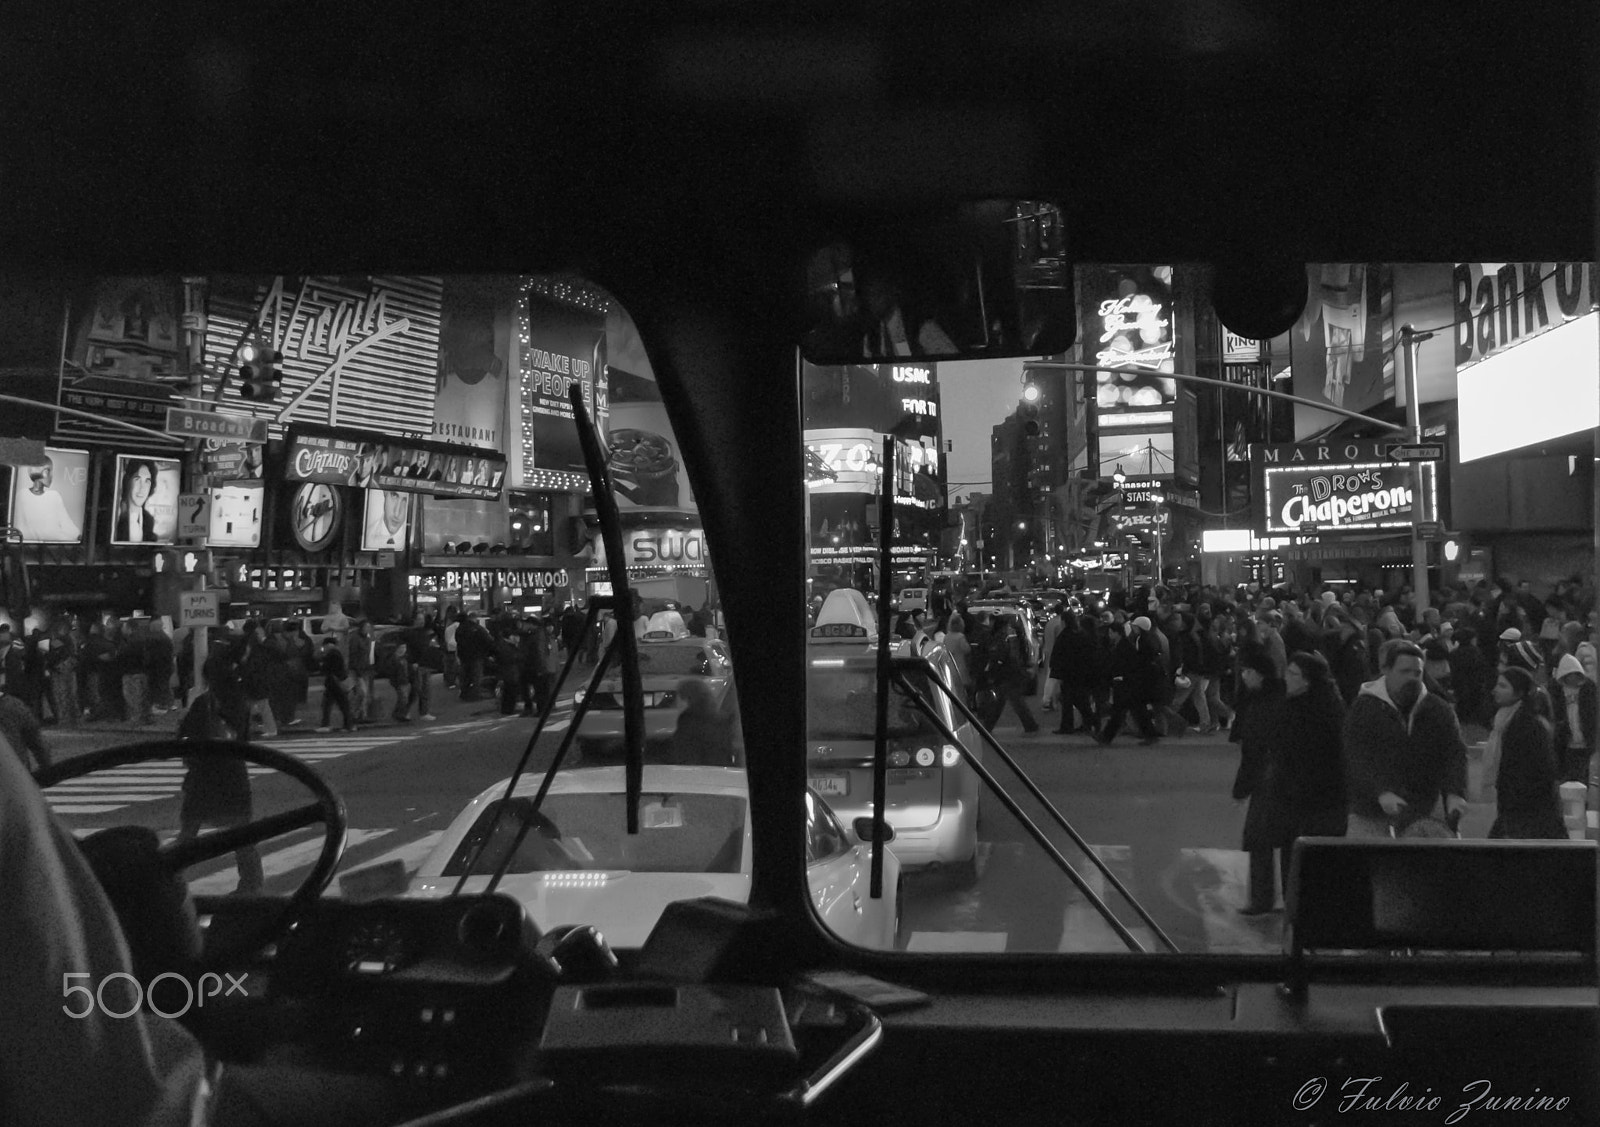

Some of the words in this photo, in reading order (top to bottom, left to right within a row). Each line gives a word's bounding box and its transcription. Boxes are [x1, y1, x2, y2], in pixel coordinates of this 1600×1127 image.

[1226, 336, 1256, 354] KING
[530, 348, 570, 375] WAKE
[571, 358, 590, 378] UP
[531, 369, 591, 403] PEOPE
[183, 415, 252, 438] Broadway
[433, 421, 495, 443] RESTAURANT
[1264, 443, 1386, 463] MARQU
[180, 497, 195, 508] NO
[183, 525, 206, 534] TURN
[633, 537, 702, 562] swa
[446, 571, 494, 589] PLANET
[497, 571, 568, 588] HOLLYWOOD
[184, 608, 215, 619] TURNS
